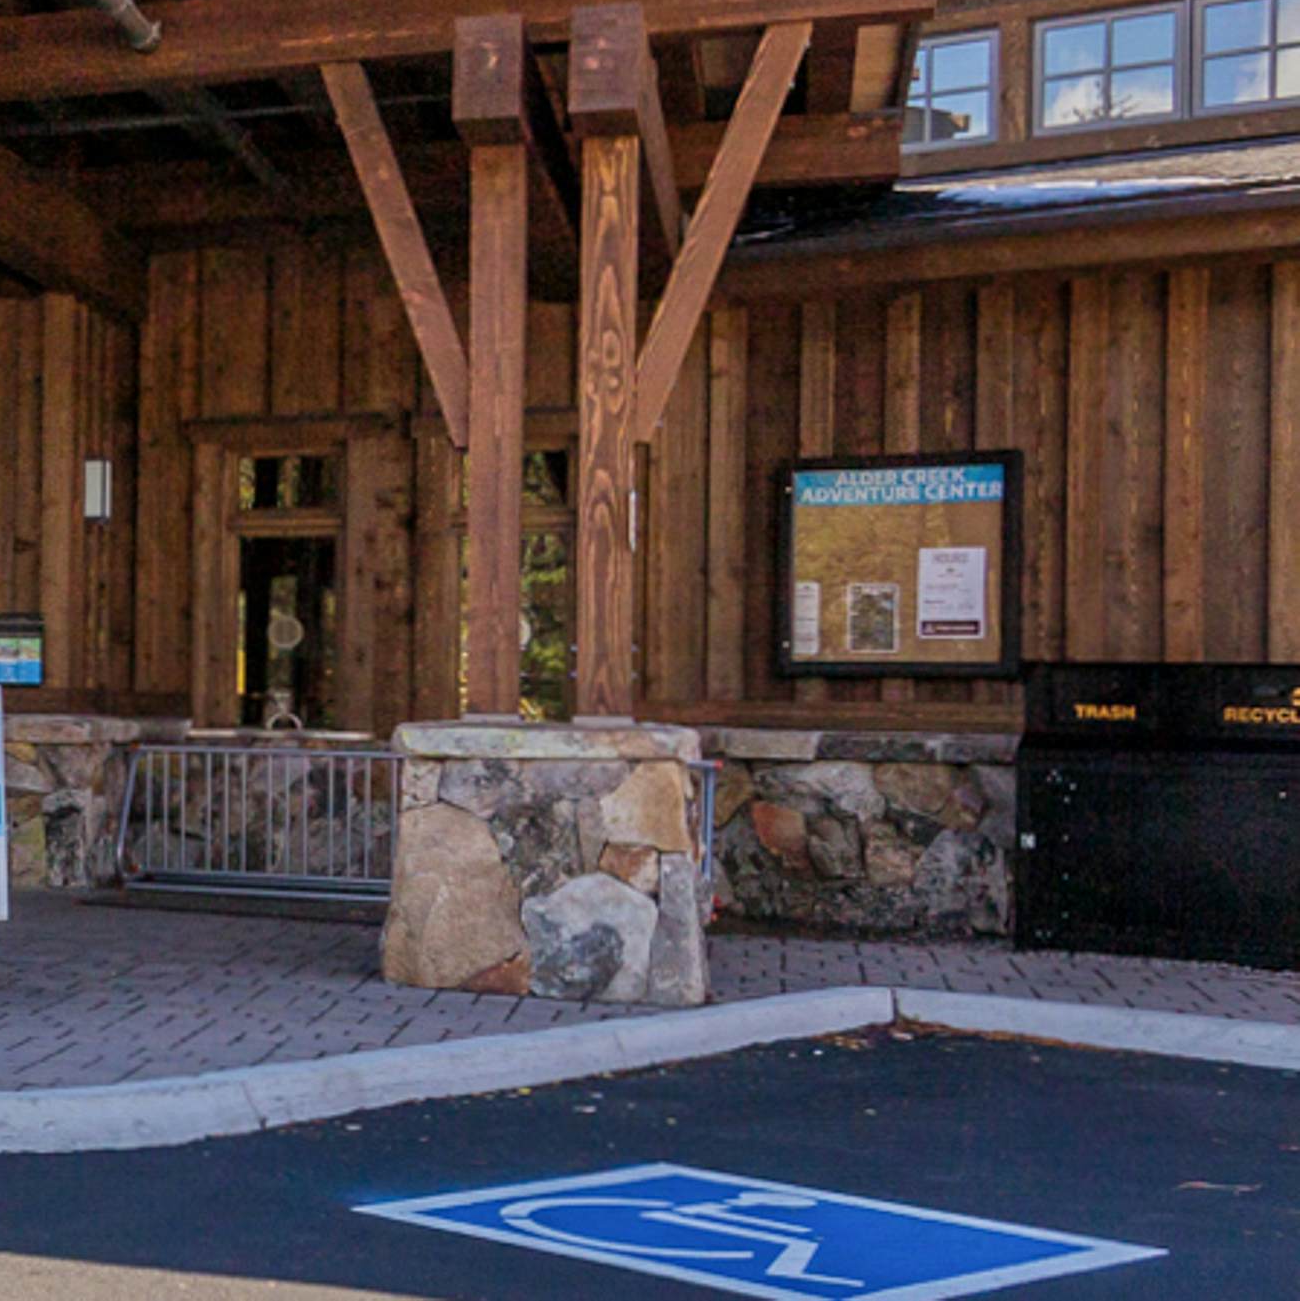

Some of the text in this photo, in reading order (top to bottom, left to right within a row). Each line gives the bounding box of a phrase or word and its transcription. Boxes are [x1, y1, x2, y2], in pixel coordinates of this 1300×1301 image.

[835, 467, 965, 487] ALDER CREEK
[802, 481, 1001, 502] ADVENTURE CENTER
[1073, 703, 1137, 720] TRASH
